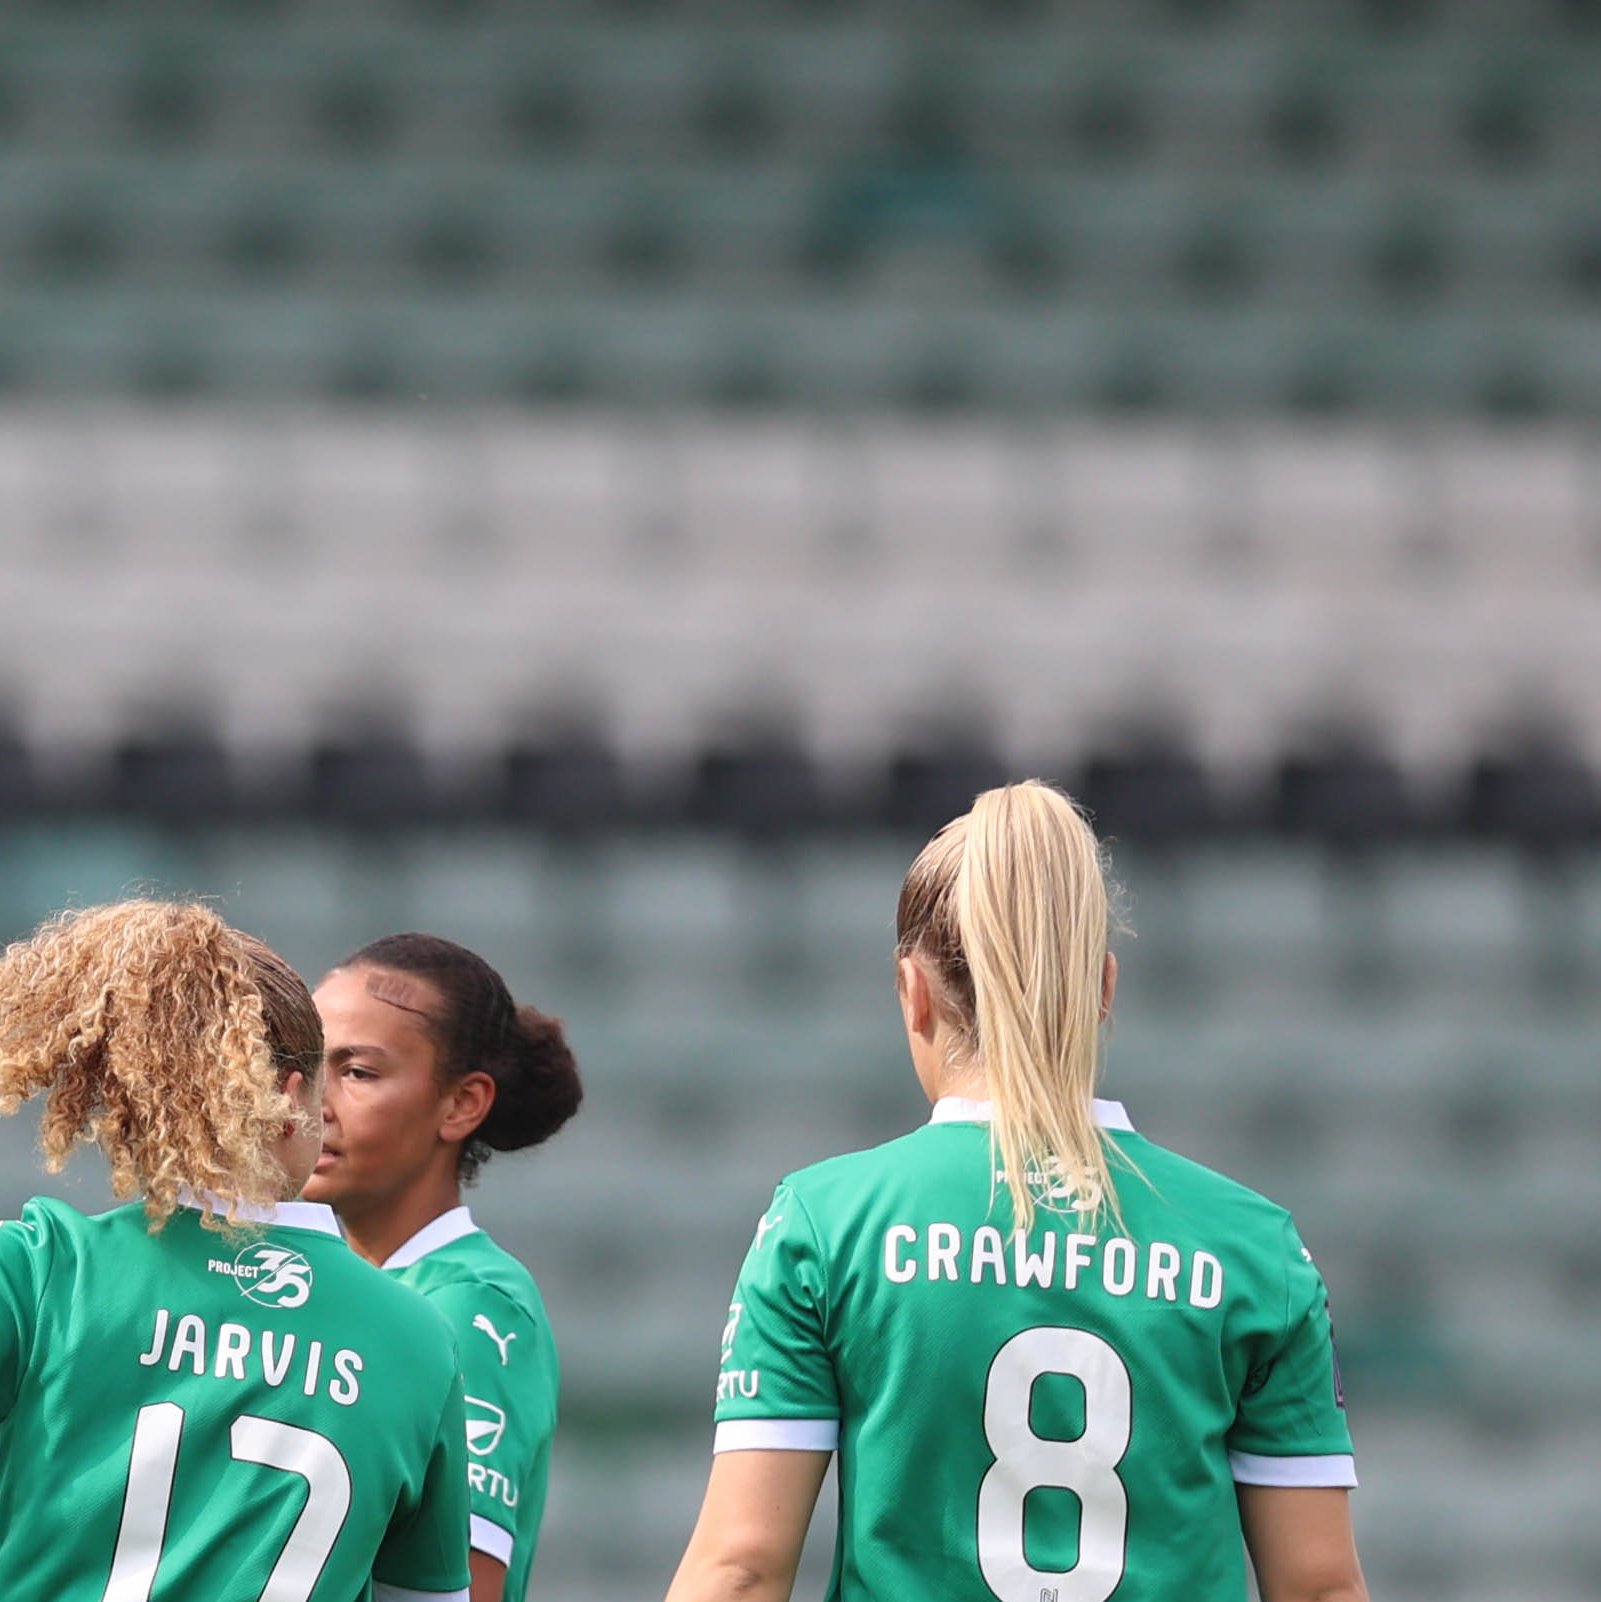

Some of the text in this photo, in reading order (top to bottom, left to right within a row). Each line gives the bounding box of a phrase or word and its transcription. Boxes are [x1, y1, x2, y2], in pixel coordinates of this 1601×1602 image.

[207, 1249, 312, 1308] PROJECT 35
[884, 1223, 1224, 1309] CRAWFORD
[138, 1308, 365, 1407] JARVIS
[467, 1461, 519, 1507] RTU
